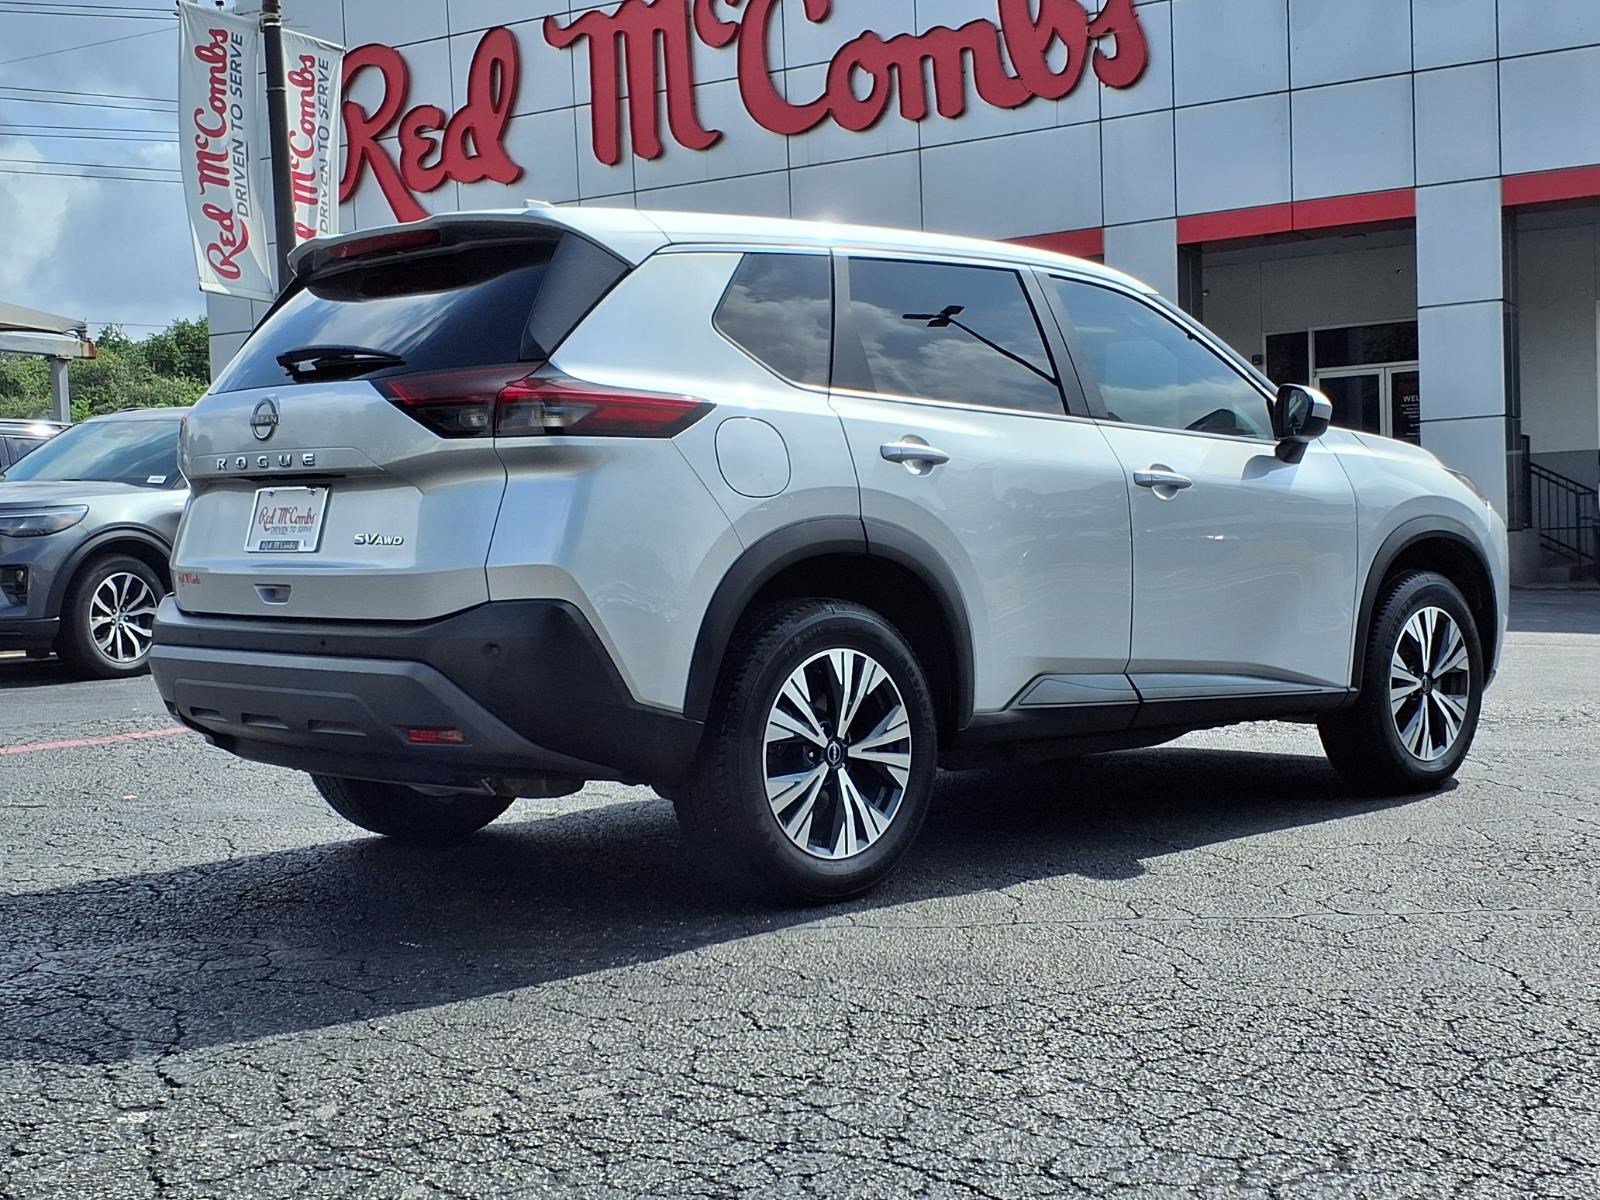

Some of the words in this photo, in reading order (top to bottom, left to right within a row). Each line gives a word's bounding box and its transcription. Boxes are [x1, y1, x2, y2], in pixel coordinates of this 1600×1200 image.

[230, 32, 244, 99] SERVE
[317, 57, 330, 120] SERVE
[194, 28, 231, 195] McCombs
[230, 103, 244, 131] TO
[287, 54, 318, 213] McCombs
[317, 126, 330, 151] TO
[339, 26, 524, 223] Red
[543, 0, 1149, 166] McCombs
[232, 138, 251, 218] DRIVEN
[318, 158, 330, 234] DRIVEN
[202, 203, 249, 280] Red
[216, 453, 317, 471] ROGUE
[259, 506, 277, 532] Red
[278, 506, 317, 525] McCombs
